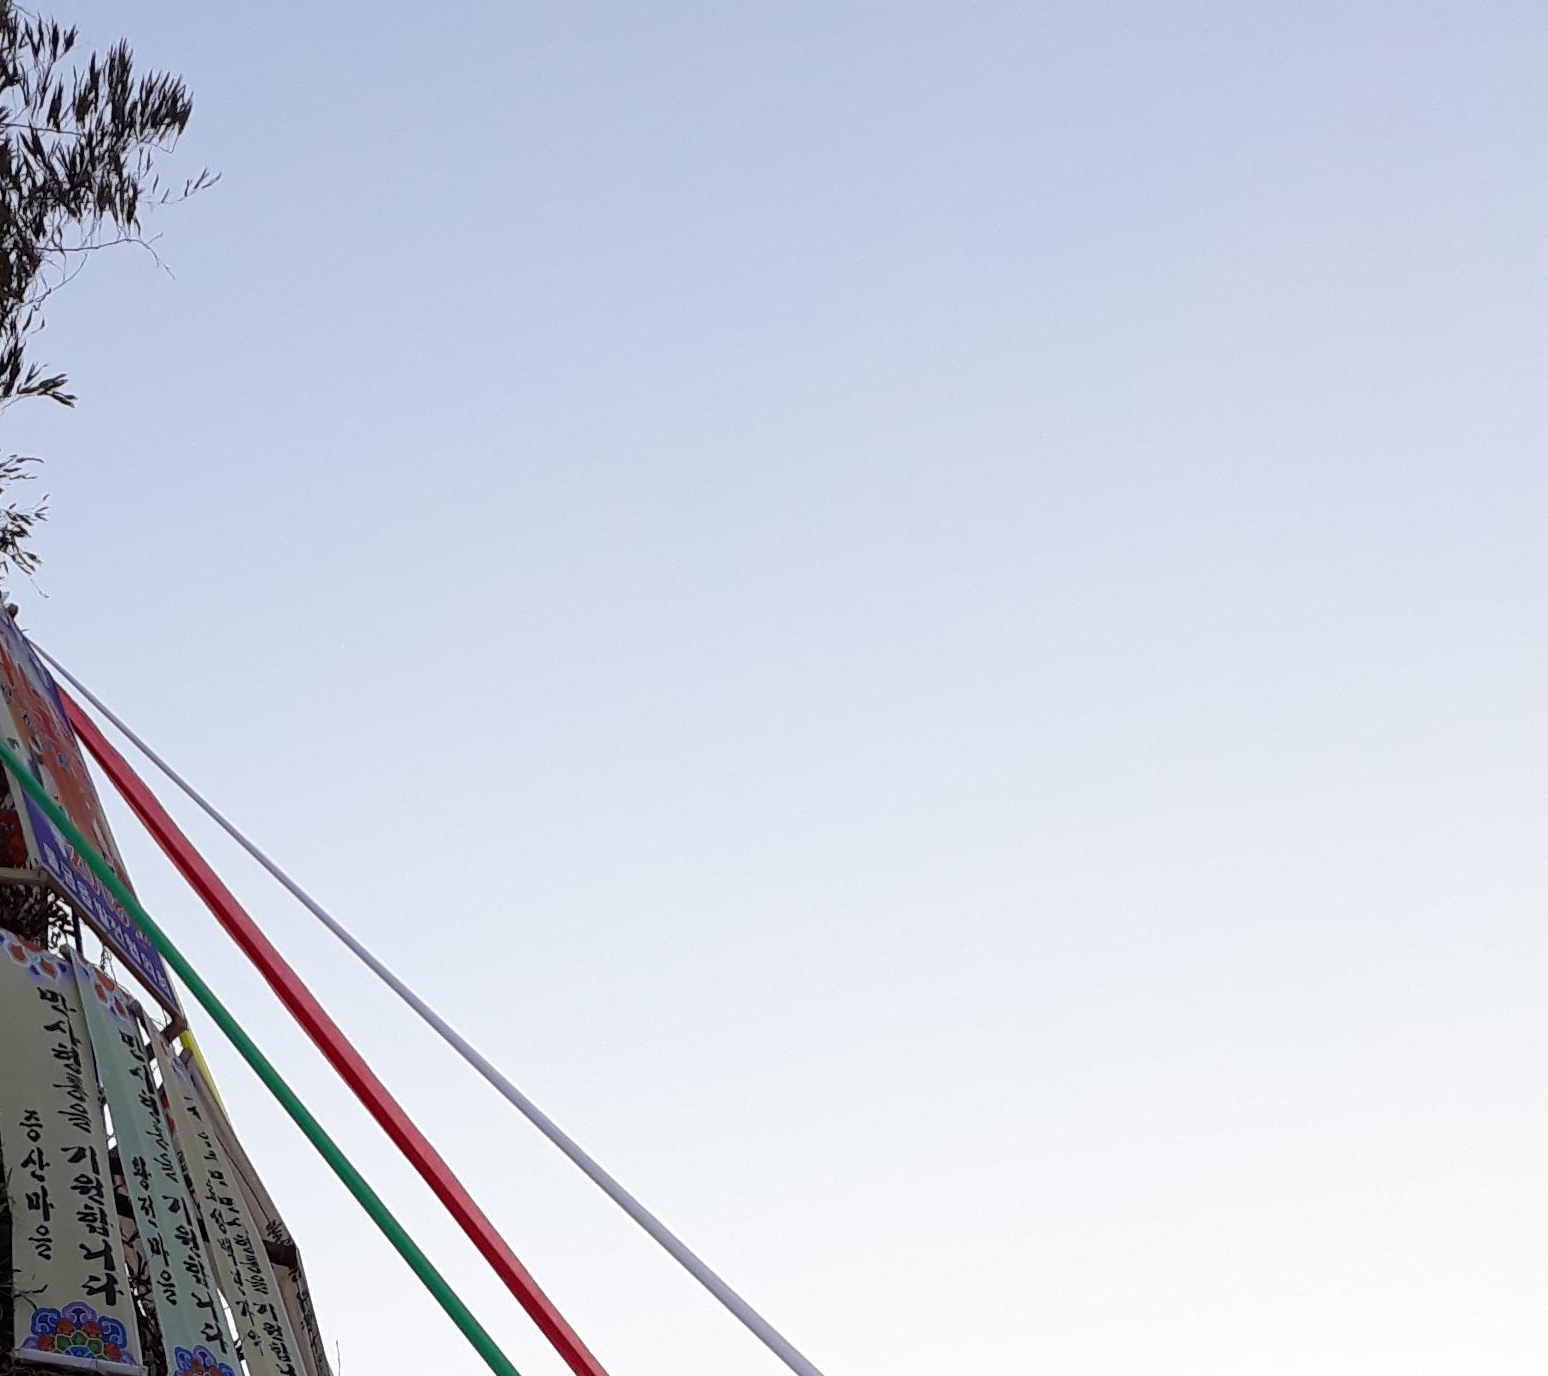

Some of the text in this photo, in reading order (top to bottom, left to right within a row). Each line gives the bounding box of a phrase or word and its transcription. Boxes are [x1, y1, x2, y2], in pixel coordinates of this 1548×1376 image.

[19, 1109, 55, 1261] 증산마을
[38, 986, 125, 1306] 만사형통을 기원합니다
[118, 1029, 181, 1185] 만사형통을
[167, 1195, 227, 1355] 기원합니다
